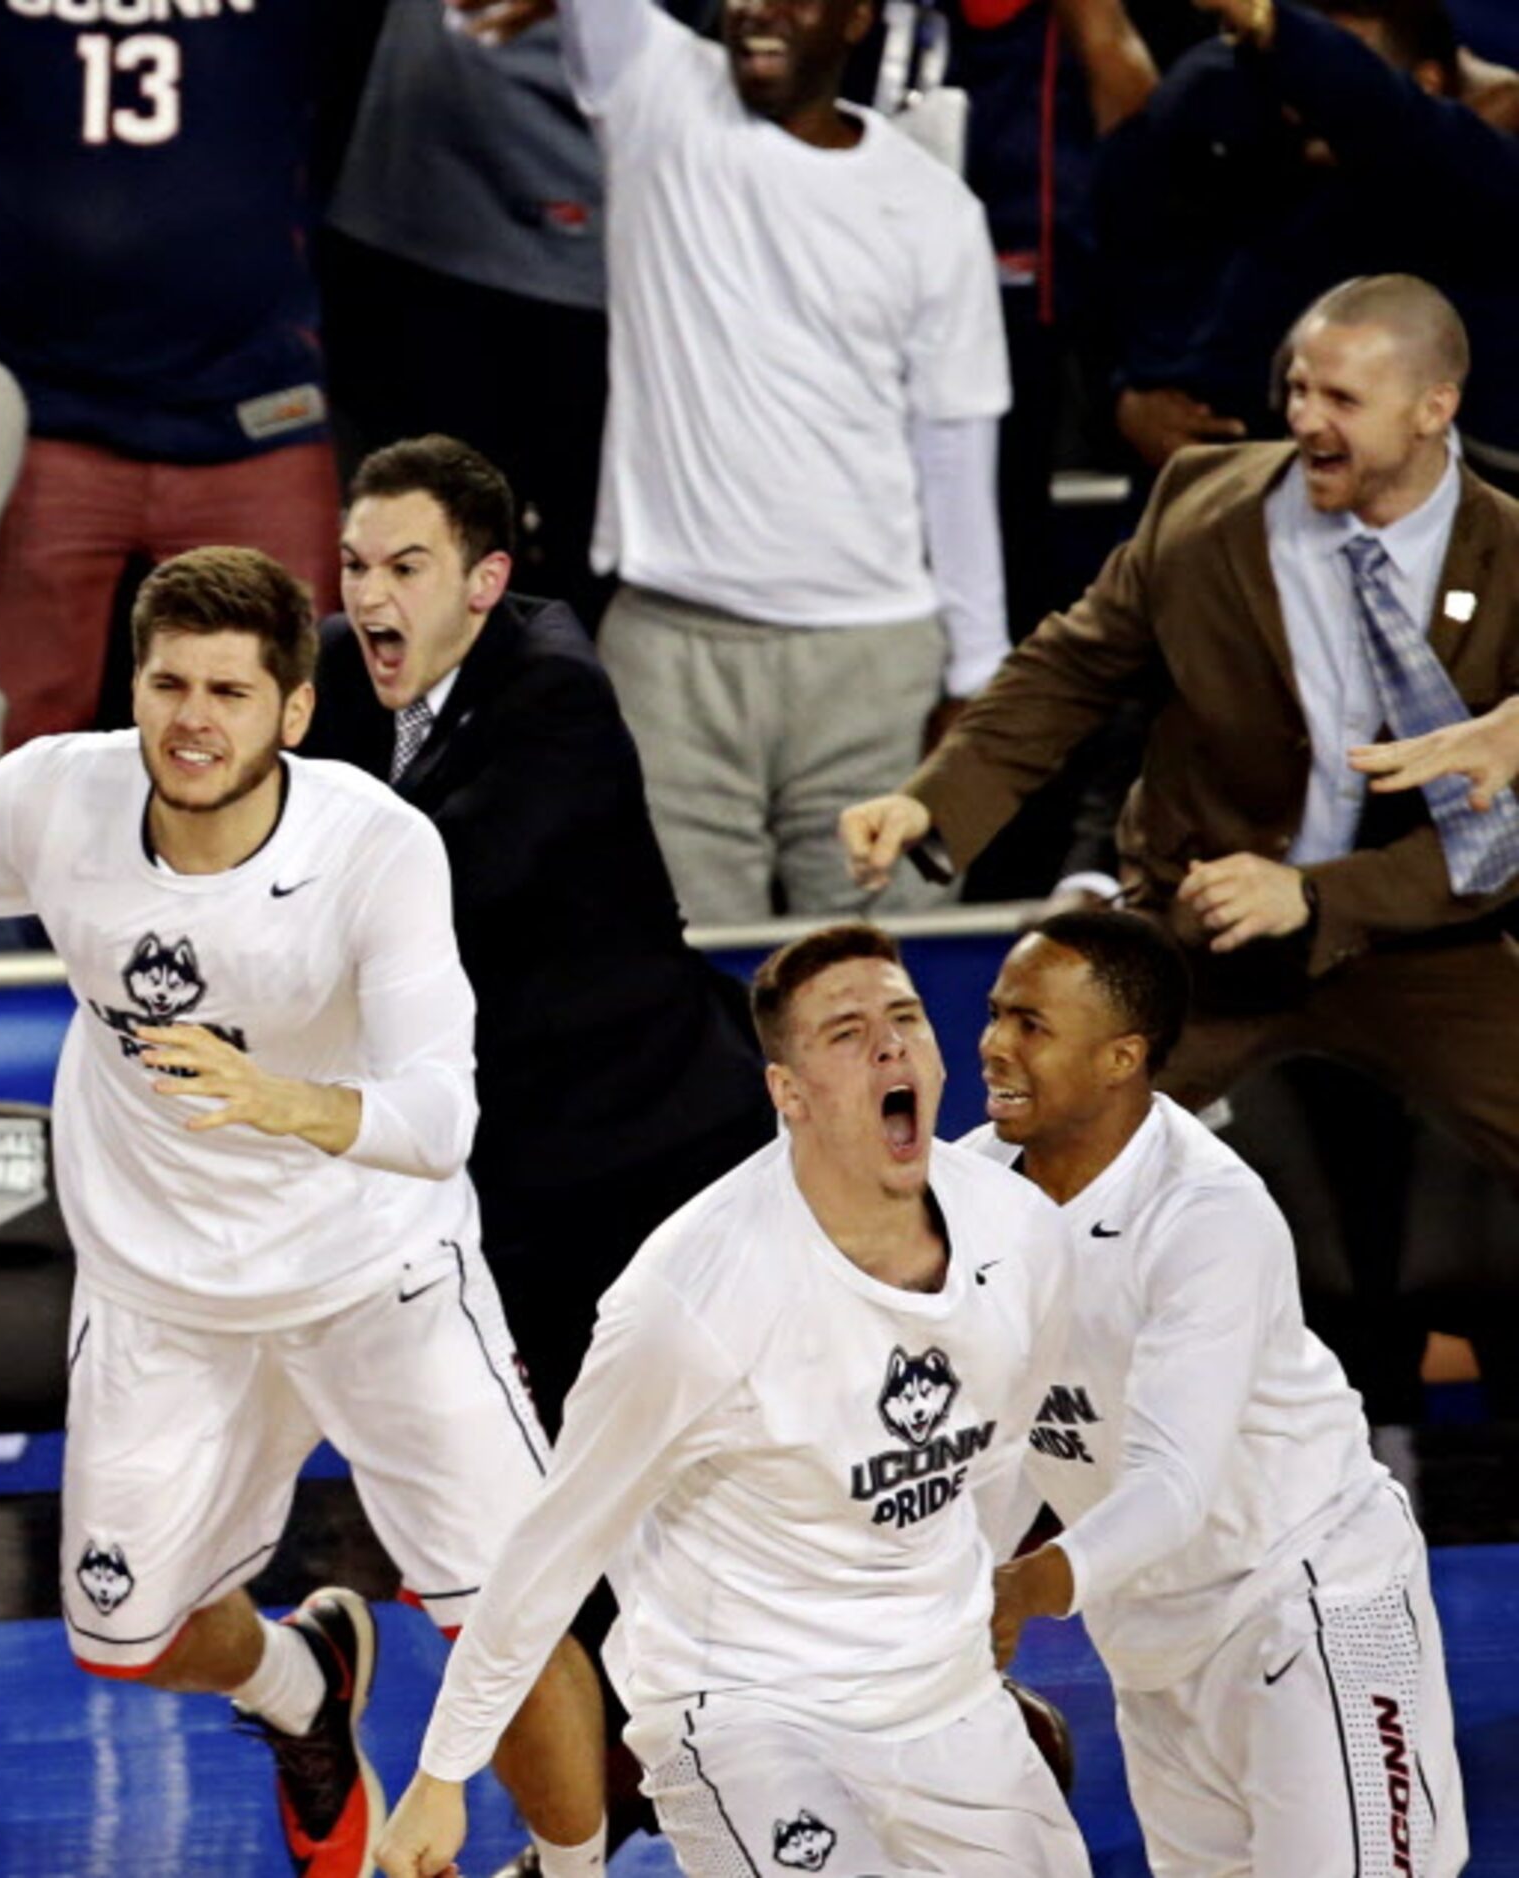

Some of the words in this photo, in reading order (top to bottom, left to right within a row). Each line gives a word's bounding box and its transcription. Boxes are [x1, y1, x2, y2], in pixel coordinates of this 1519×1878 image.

[77, 33, 181, 145] 13
[850, 1420, 998, 1502] UCONN
[871, 1465, 968, 1530] PRIDE
